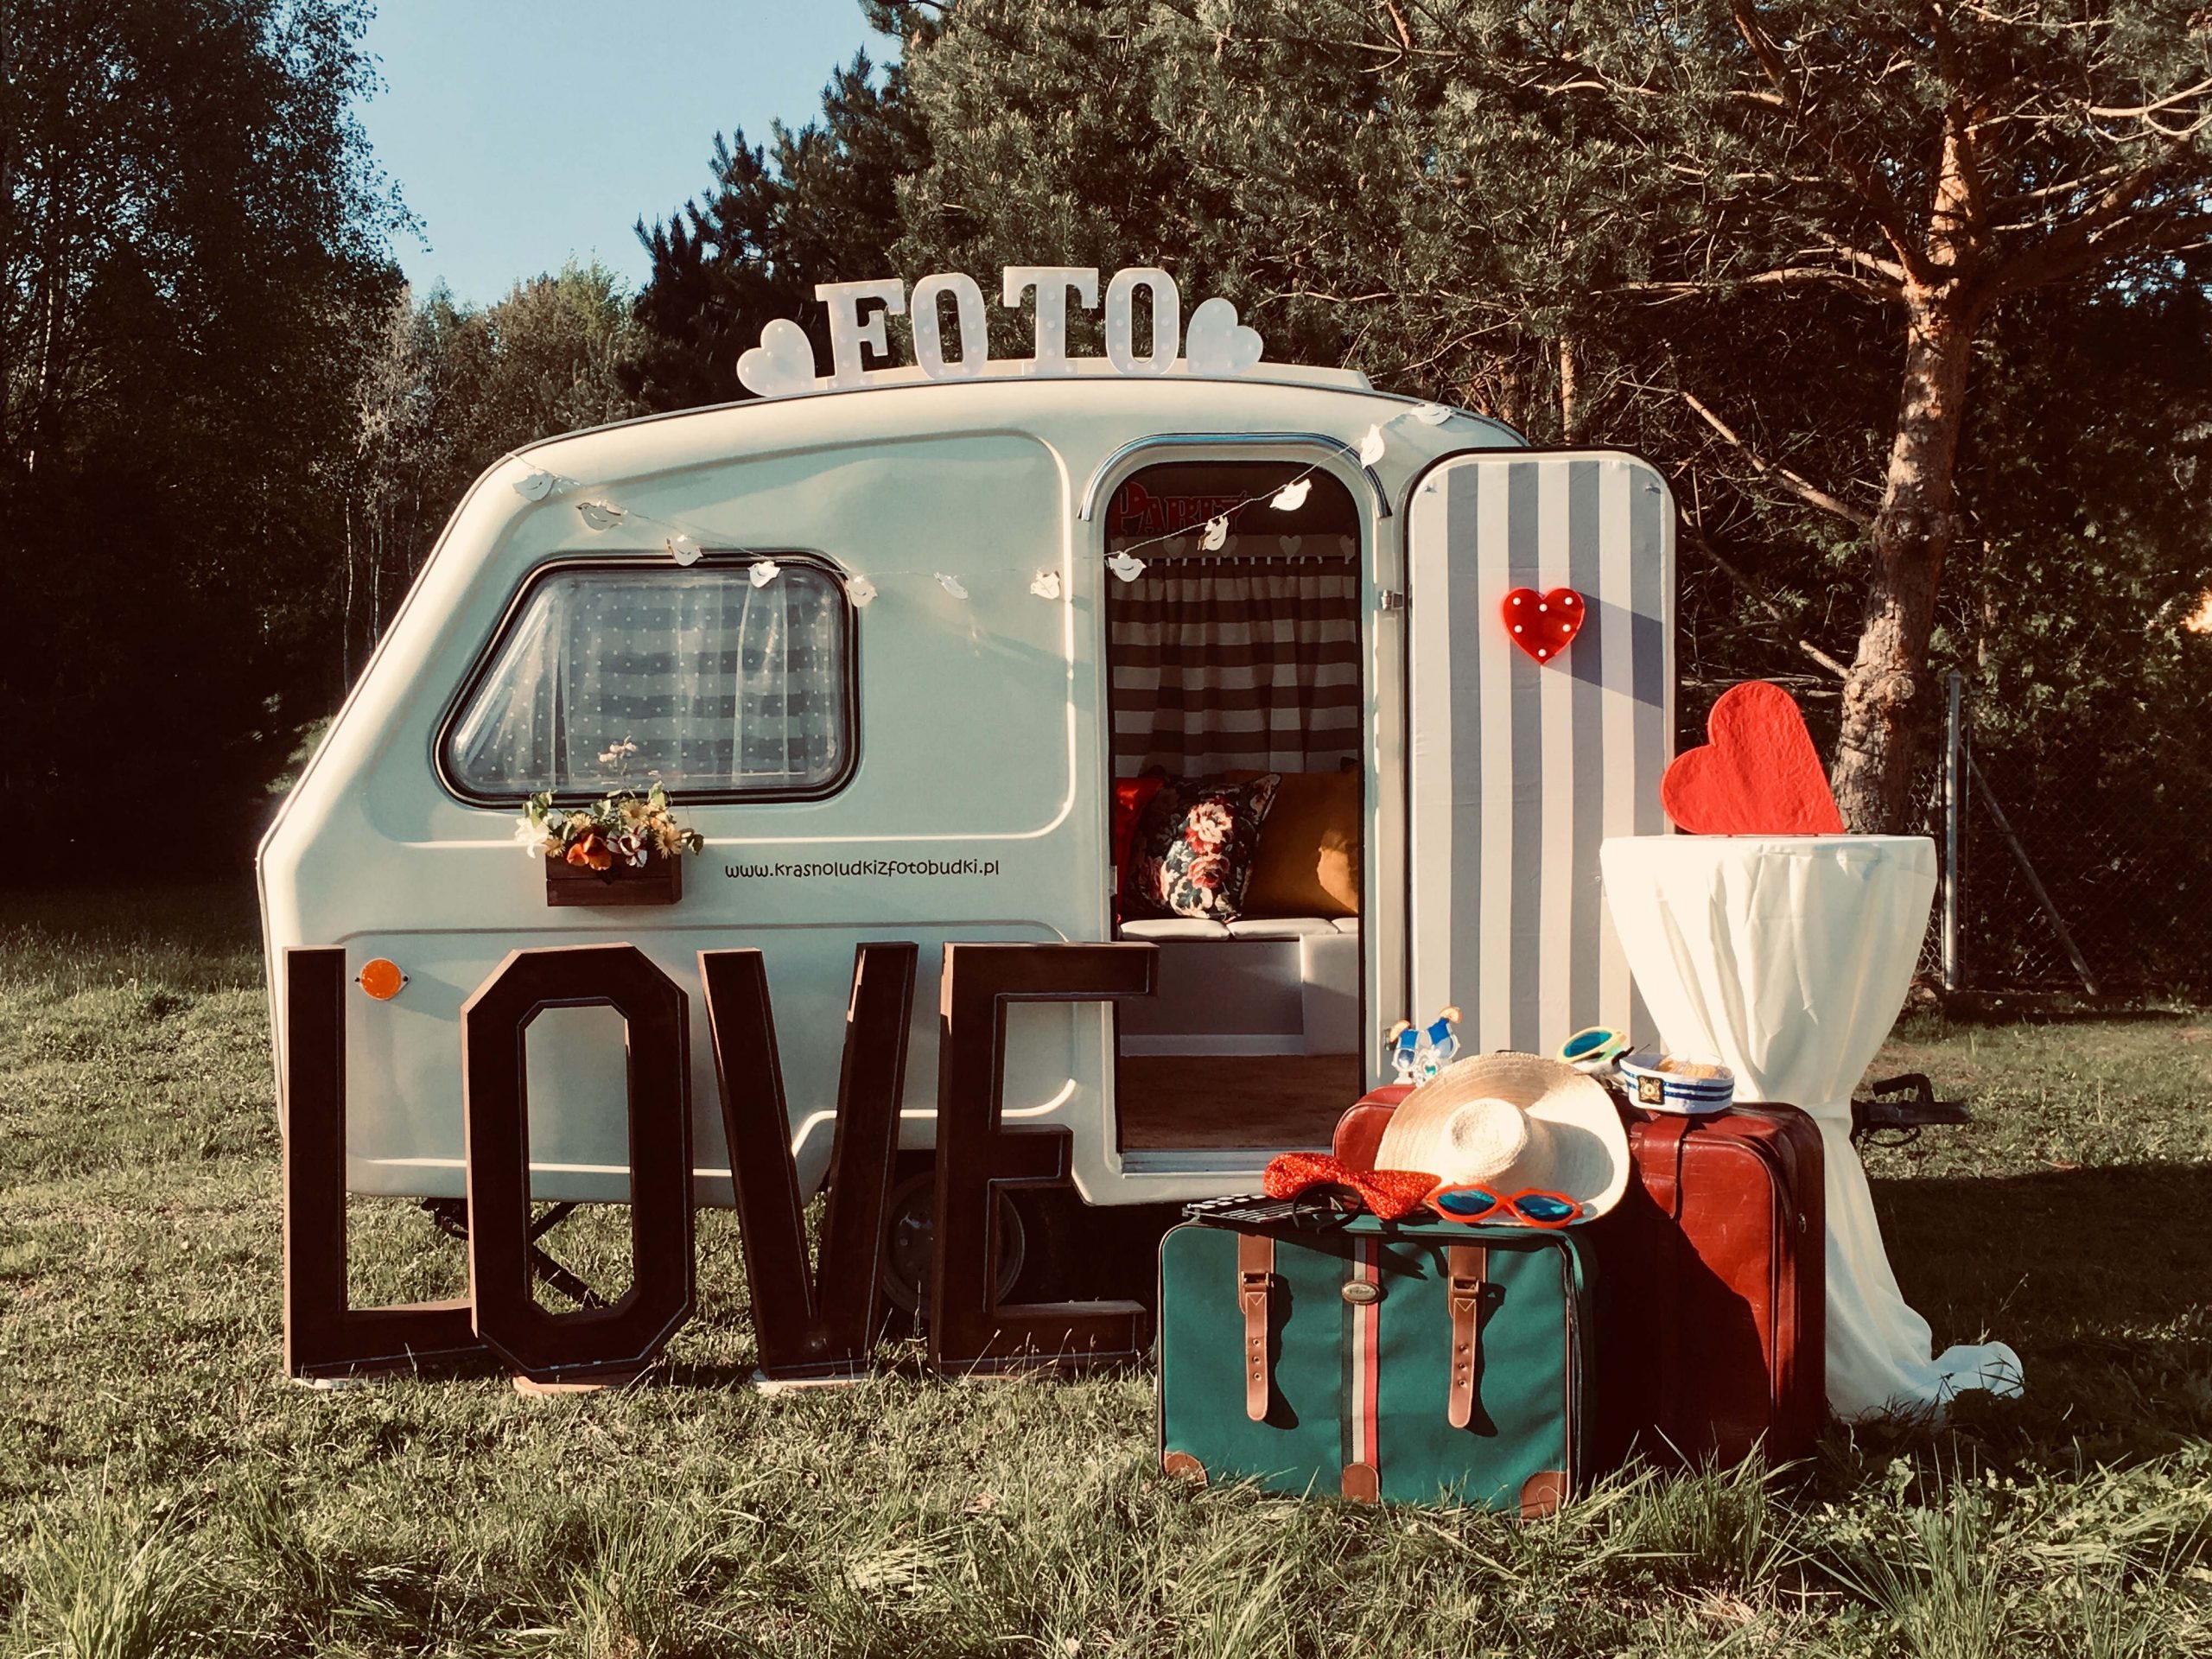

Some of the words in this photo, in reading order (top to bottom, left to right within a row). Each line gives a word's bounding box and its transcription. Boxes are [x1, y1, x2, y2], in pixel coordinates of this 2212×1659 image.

[815, 266, 1180, 390] FOTO
[724, 859, 1000, 878] www.krasnoludkizfotobudki.pl
[283, 941, 1159, 1382] LOVE
